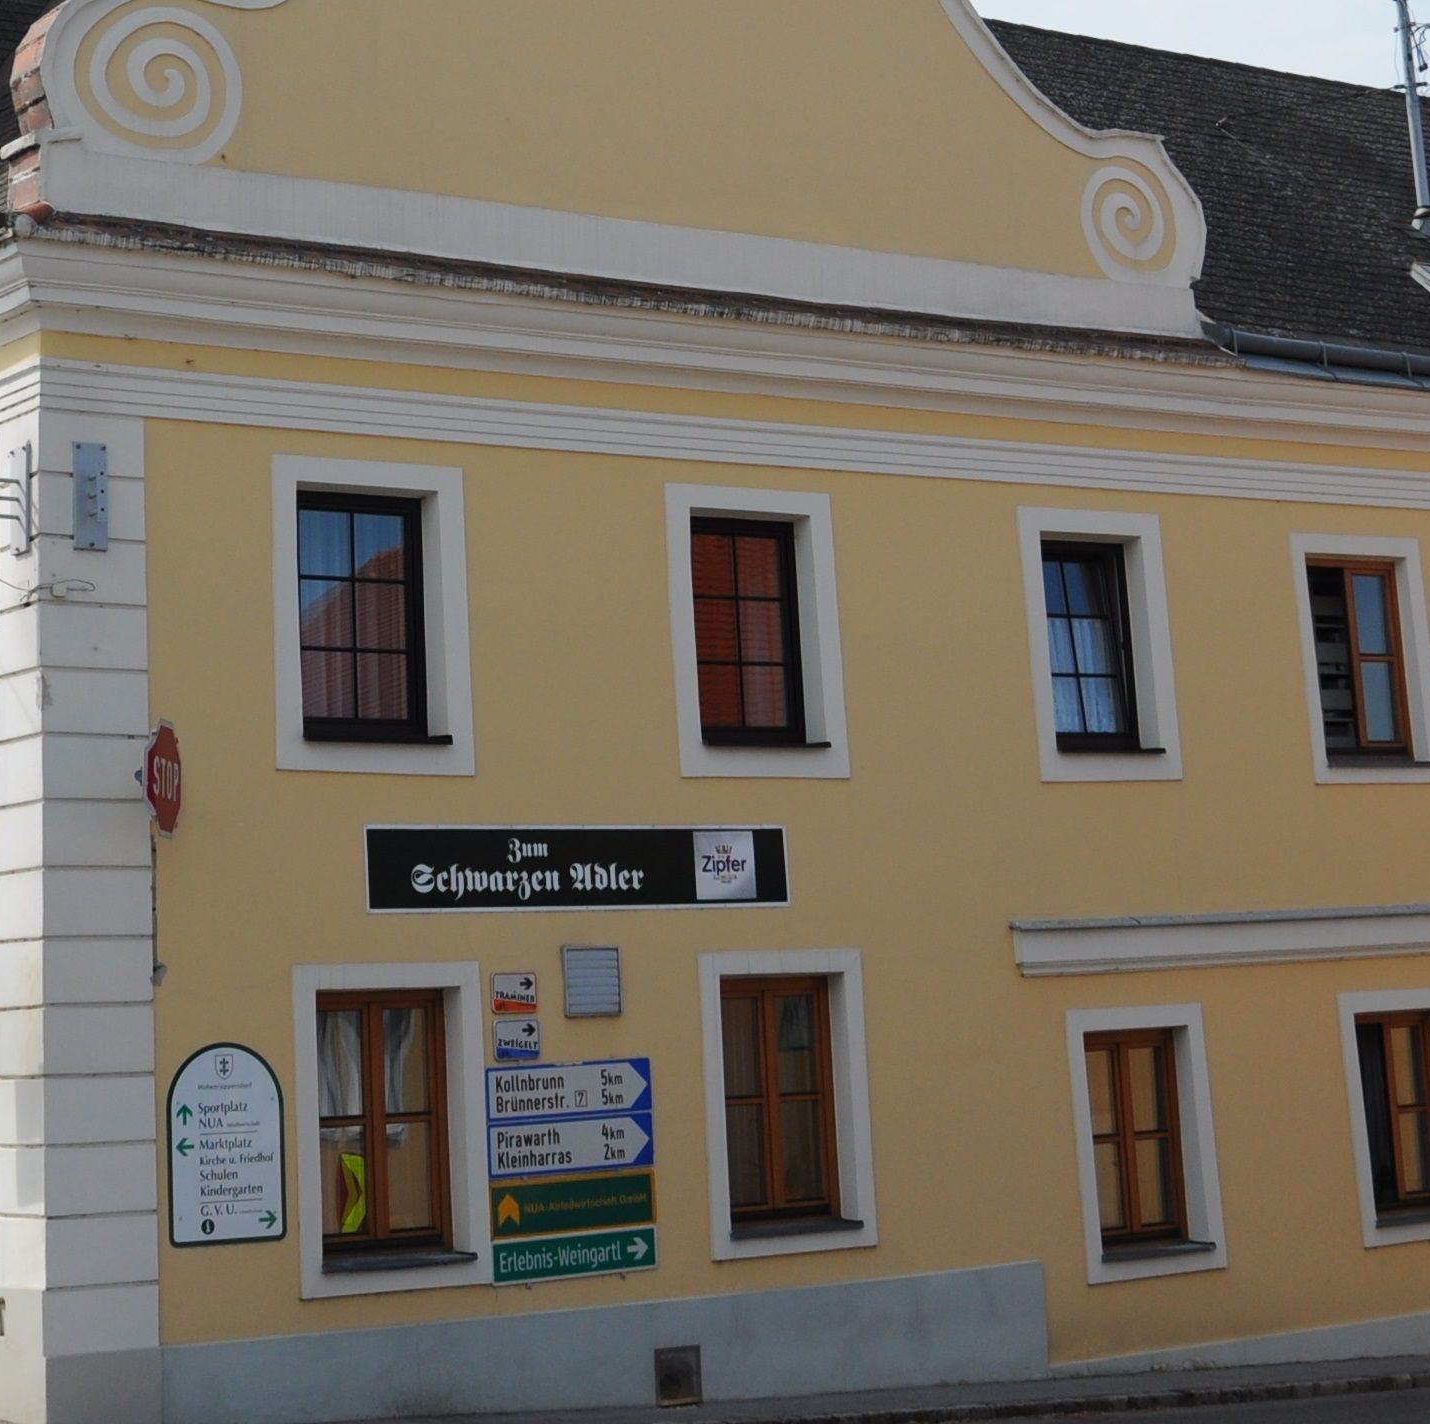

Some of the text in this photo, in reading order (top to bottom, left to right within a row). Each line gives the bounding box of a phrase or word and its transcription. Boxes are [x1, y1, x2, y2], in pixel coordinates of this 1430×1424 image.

[153, 755, 179, 802] STOP
[507, 837, 549, 863] Zum
[701, 855, 747, 876] Zipfer
[410, 862, 645, 901] Schwarzen Adler
[495, 1069, 623, 1094] Kollnbrunn 5km
[198, 1100, 248, 1117] Sportplatz
[496, 1092, 570, 1114] Brünnerstr.
[601, 1088, 624, 1106] 5km
[198, 1117, 223, 1129] NUA
[199, 1137, 252, 1152] Marktplatz
[497, 1123, 625, 1150] Pirawarth 4km
[199, 1154, 226, 1166] Kirche
[239, 1152, 274, 1164] Friedhof
[497, 1143, 626, 1171] Kleinharras 2km
[199, 1168, 238, 1182] Schulen
[200, 1184, 263, 1198] Kindergarten
[499, 1240, 622, 1274] Erlebnis-Weingartl
